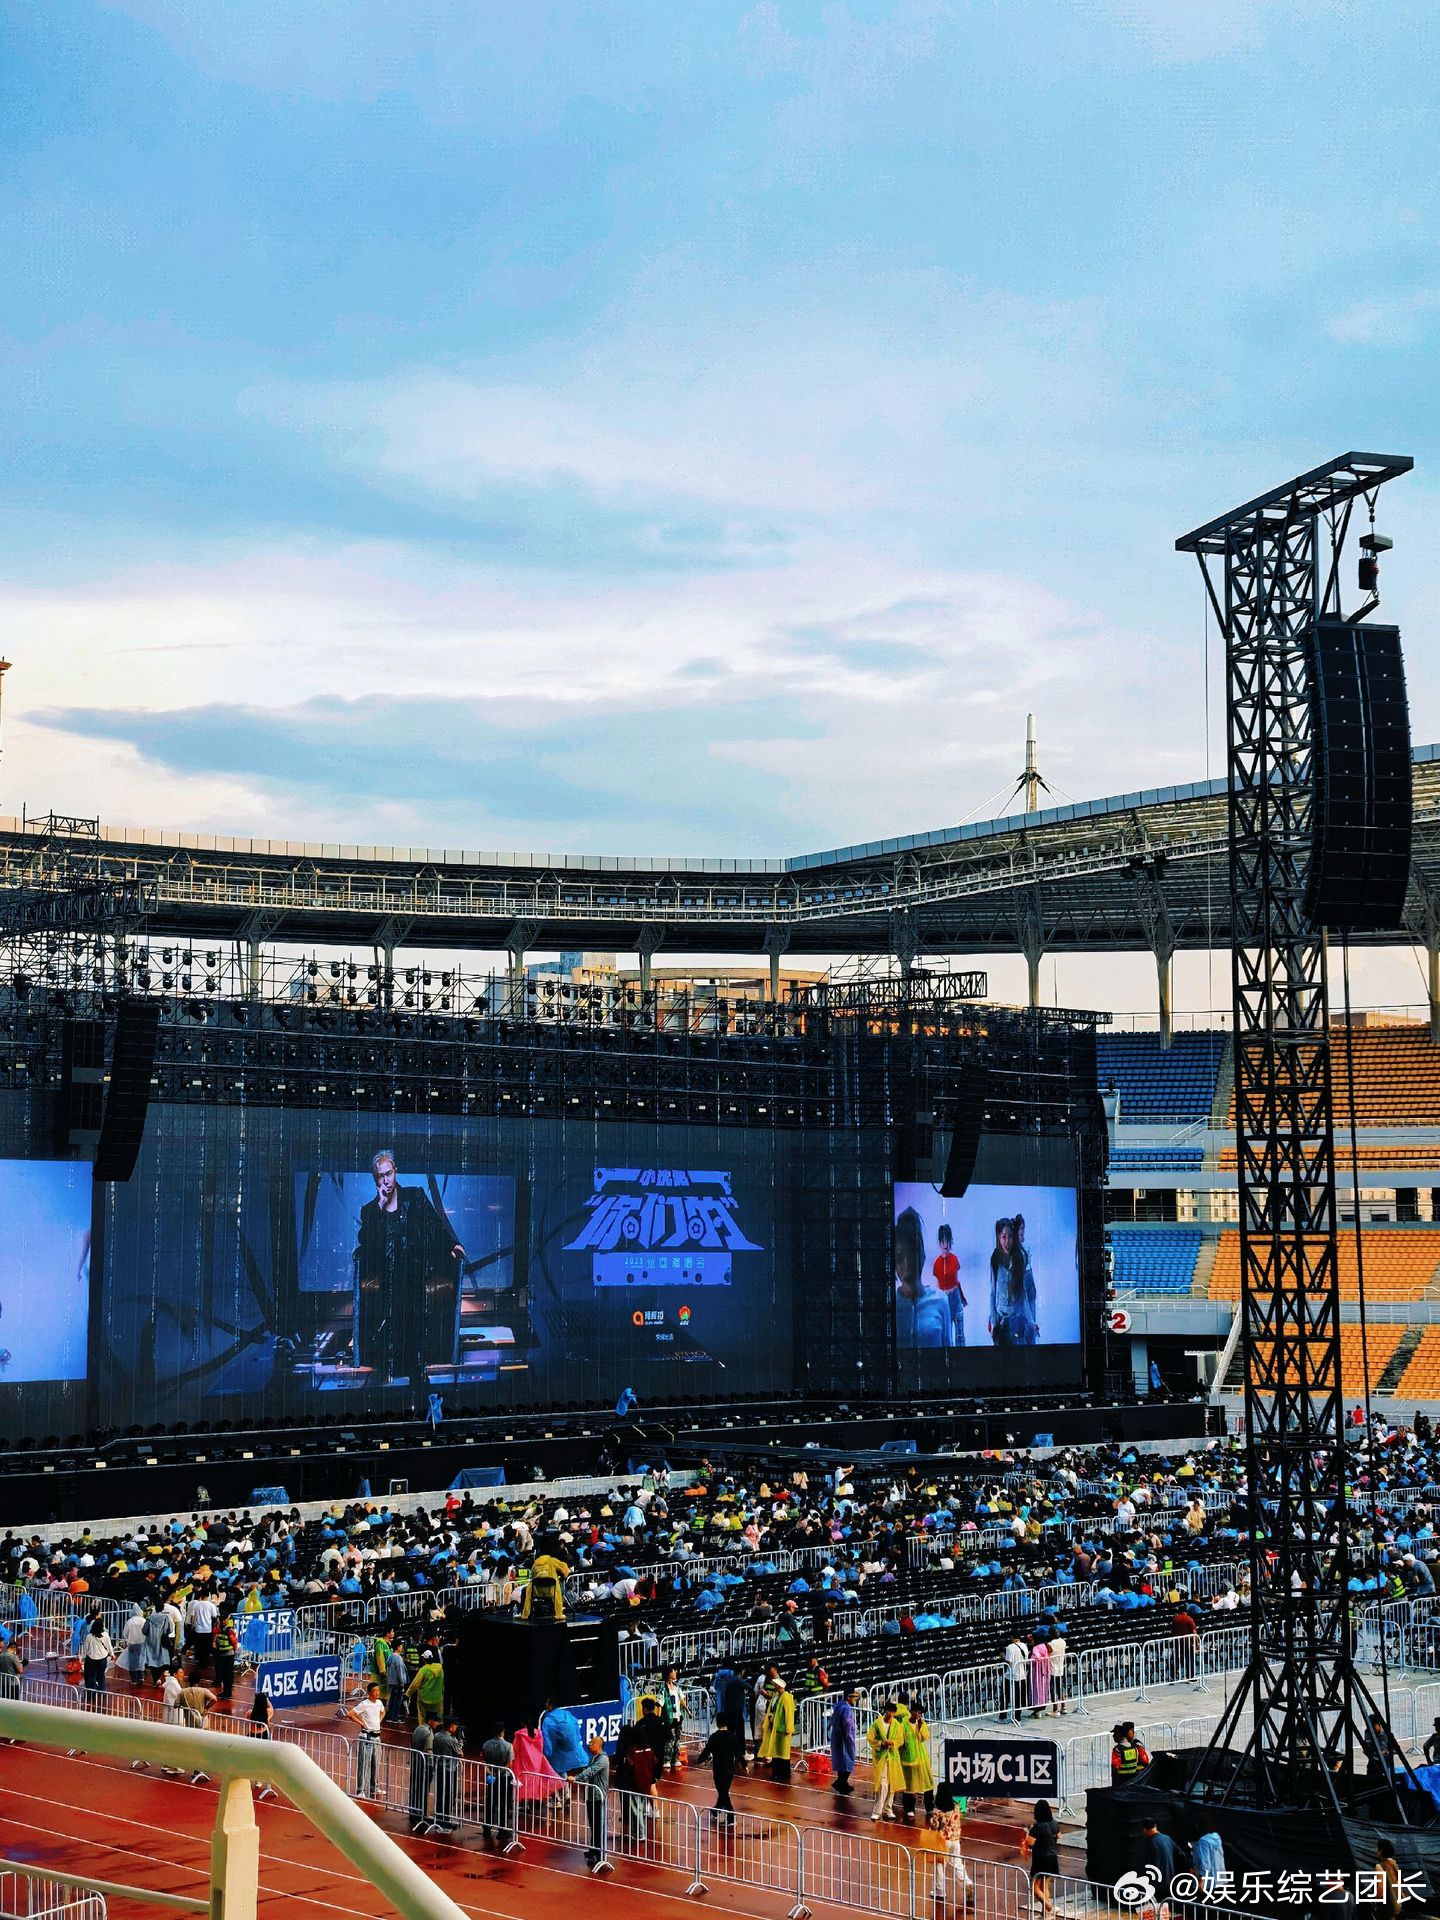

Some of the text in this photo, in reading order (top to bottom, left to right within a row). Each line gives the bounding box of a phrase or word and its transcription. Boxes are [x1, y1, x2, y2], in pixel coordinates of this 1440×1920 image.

[1112, 1312, 1127, 1329] 2
[261, 1666, 339, 1698] A5区 A6区
[948, 1751, 1053, 1785] 内场C1区
